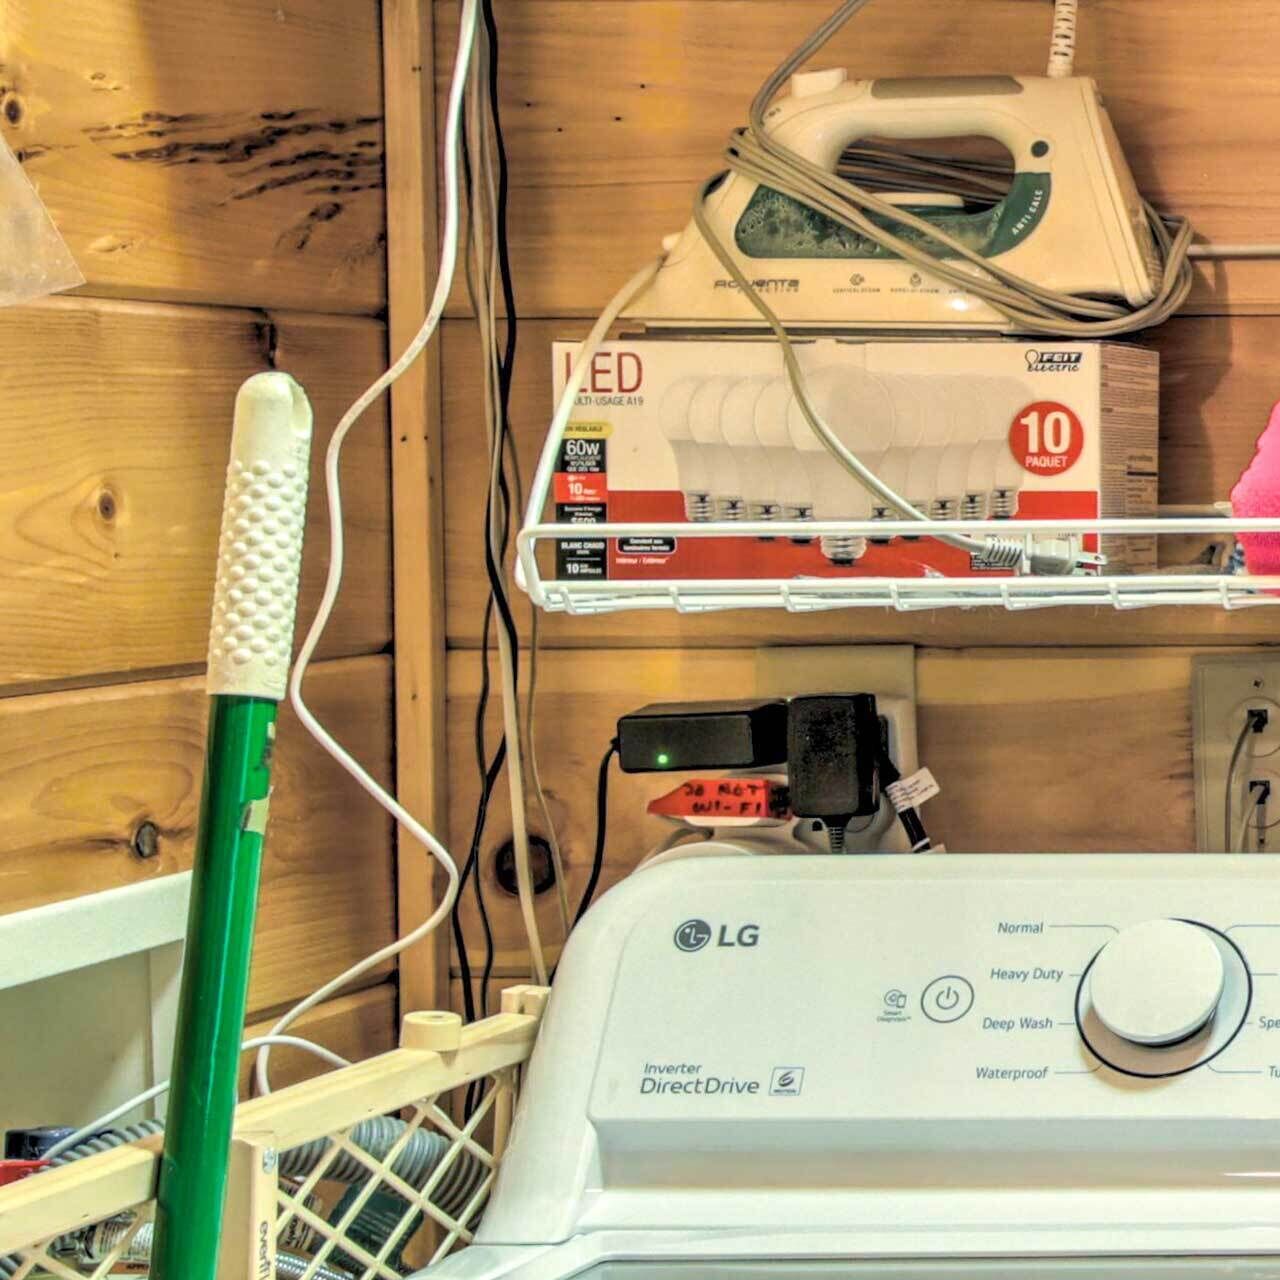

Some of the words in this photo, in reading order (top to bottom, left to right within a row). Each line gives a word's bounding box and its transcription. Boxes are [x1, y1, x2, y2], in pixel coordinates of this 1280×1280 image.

[1042, 352, 1081, 363] FEIT
[565, 352, 643, 393] LED
[573, 396, 624, 406] ULTI-USAGE
[626, 396, 644, 406] A19
[1020, 411, 1070, 454] 10
[1025, 456, 1068, 467] PAQUET
[566, 564, 579, 574] 10
[997, 922, 1044, 934] Normal
[717, 924, 760, 947] LG
[990, 968, 1029, 981] Heavy
[1032, 968, 1064, 981] Duty
[982, 1018, 1015, 1031] Deep
[1020, 1018, 1053, 1029] Wash
[644, 1062, 702, 1075] Inverter
[975, 1067, 1048, 1081] Waterproof
